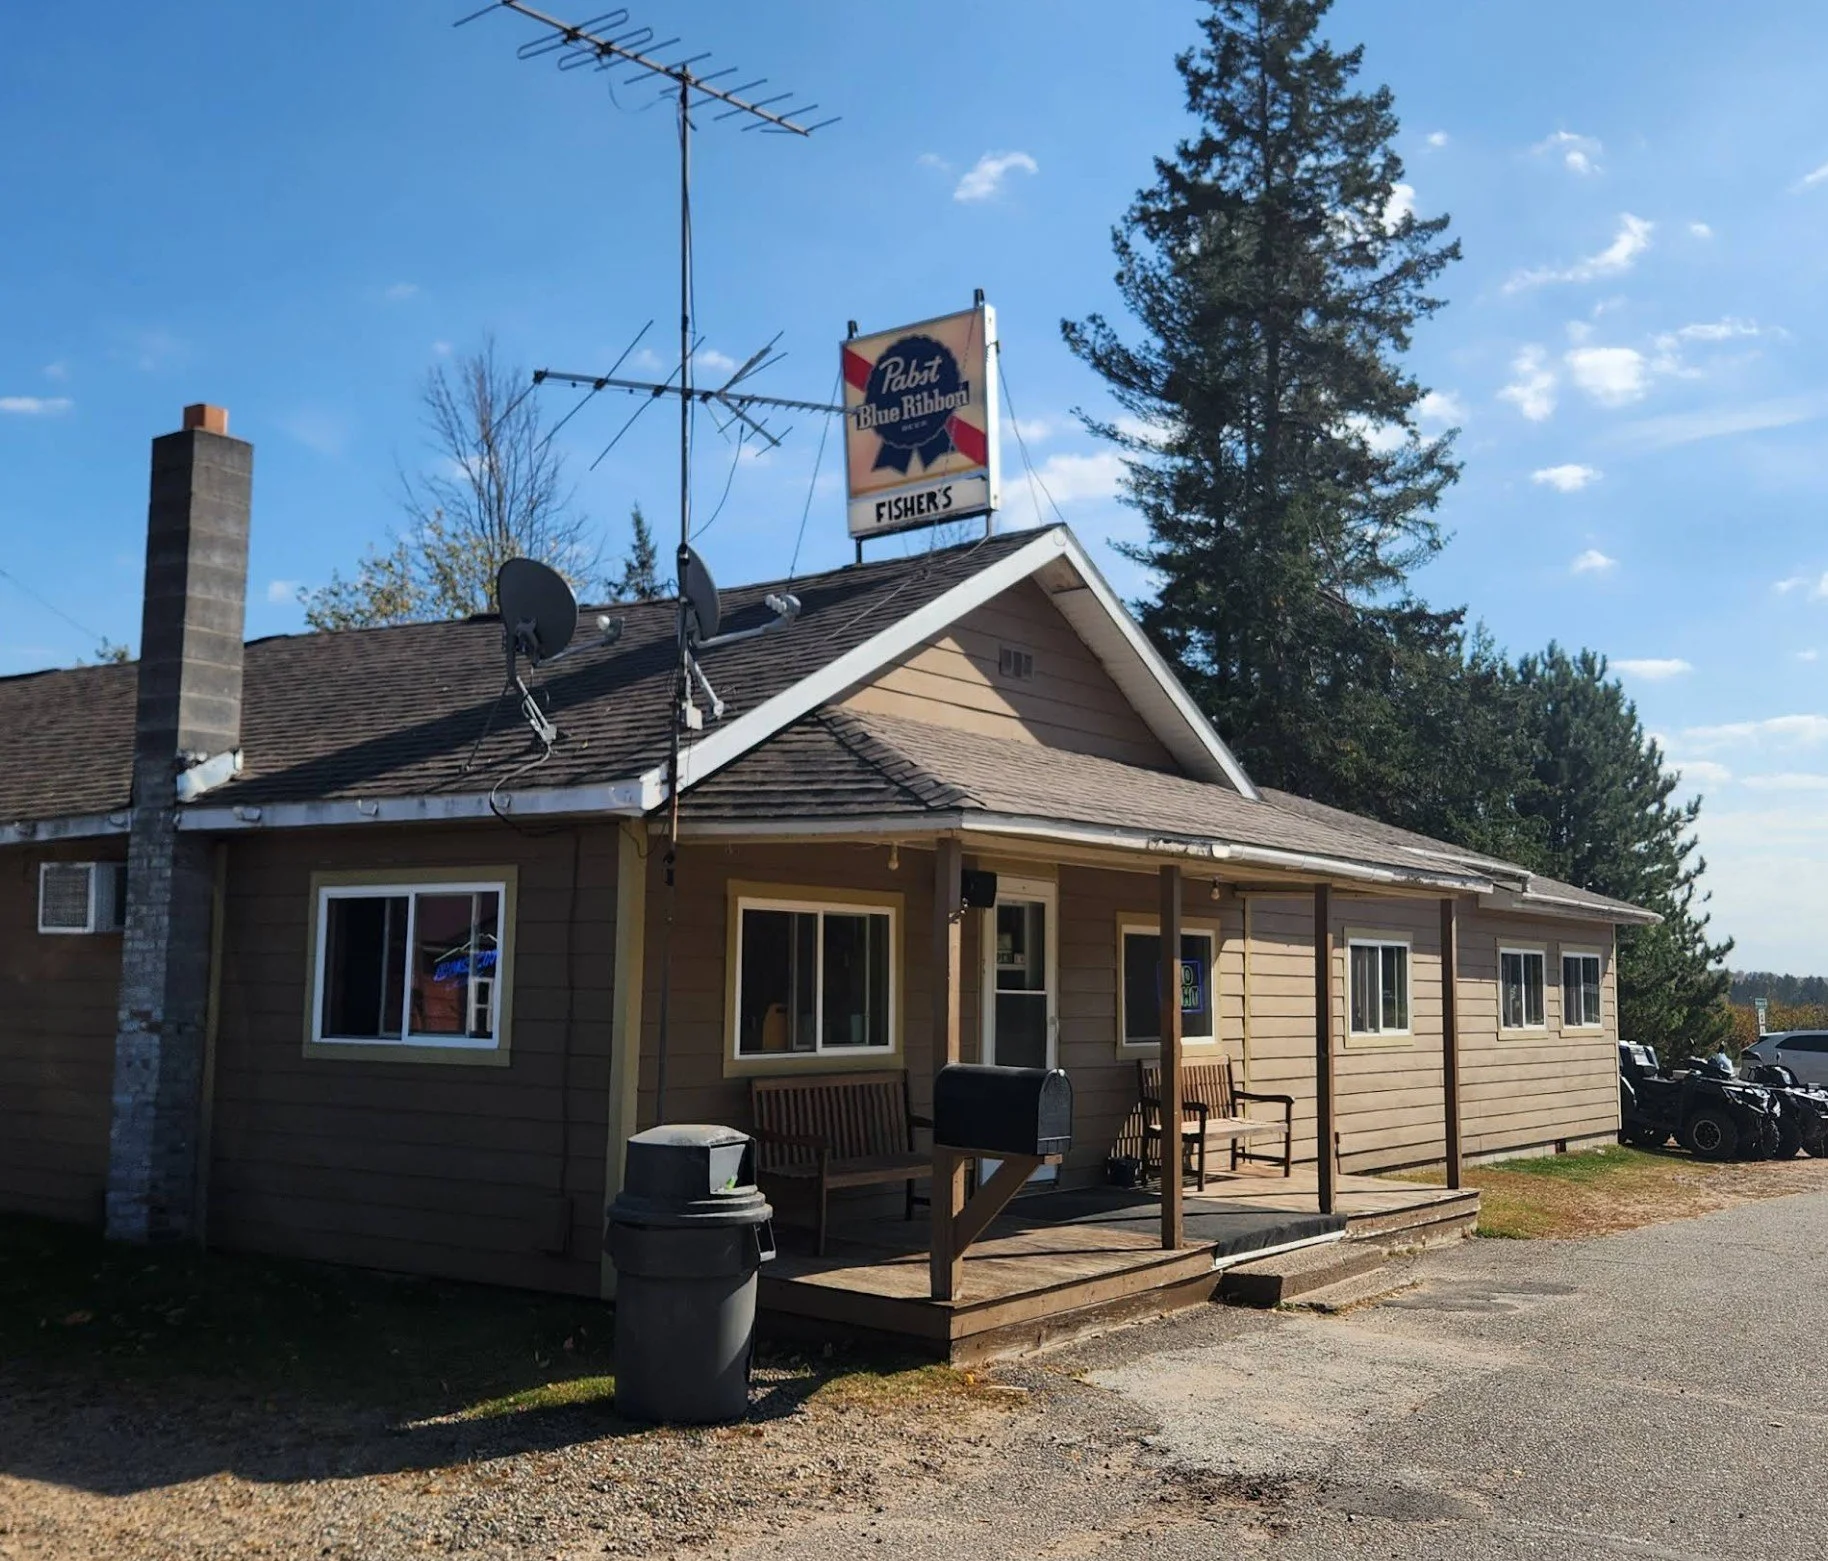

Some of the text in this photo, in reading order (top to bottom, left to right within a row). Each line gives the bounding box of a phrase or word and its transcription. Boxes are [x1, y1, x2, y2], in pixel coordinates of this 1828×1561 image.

[879, 355, 943, 394] Pabst
[859, 388, 969, 429] Blue Ribbon
[875, 485, 952, 523] FISHER'S
